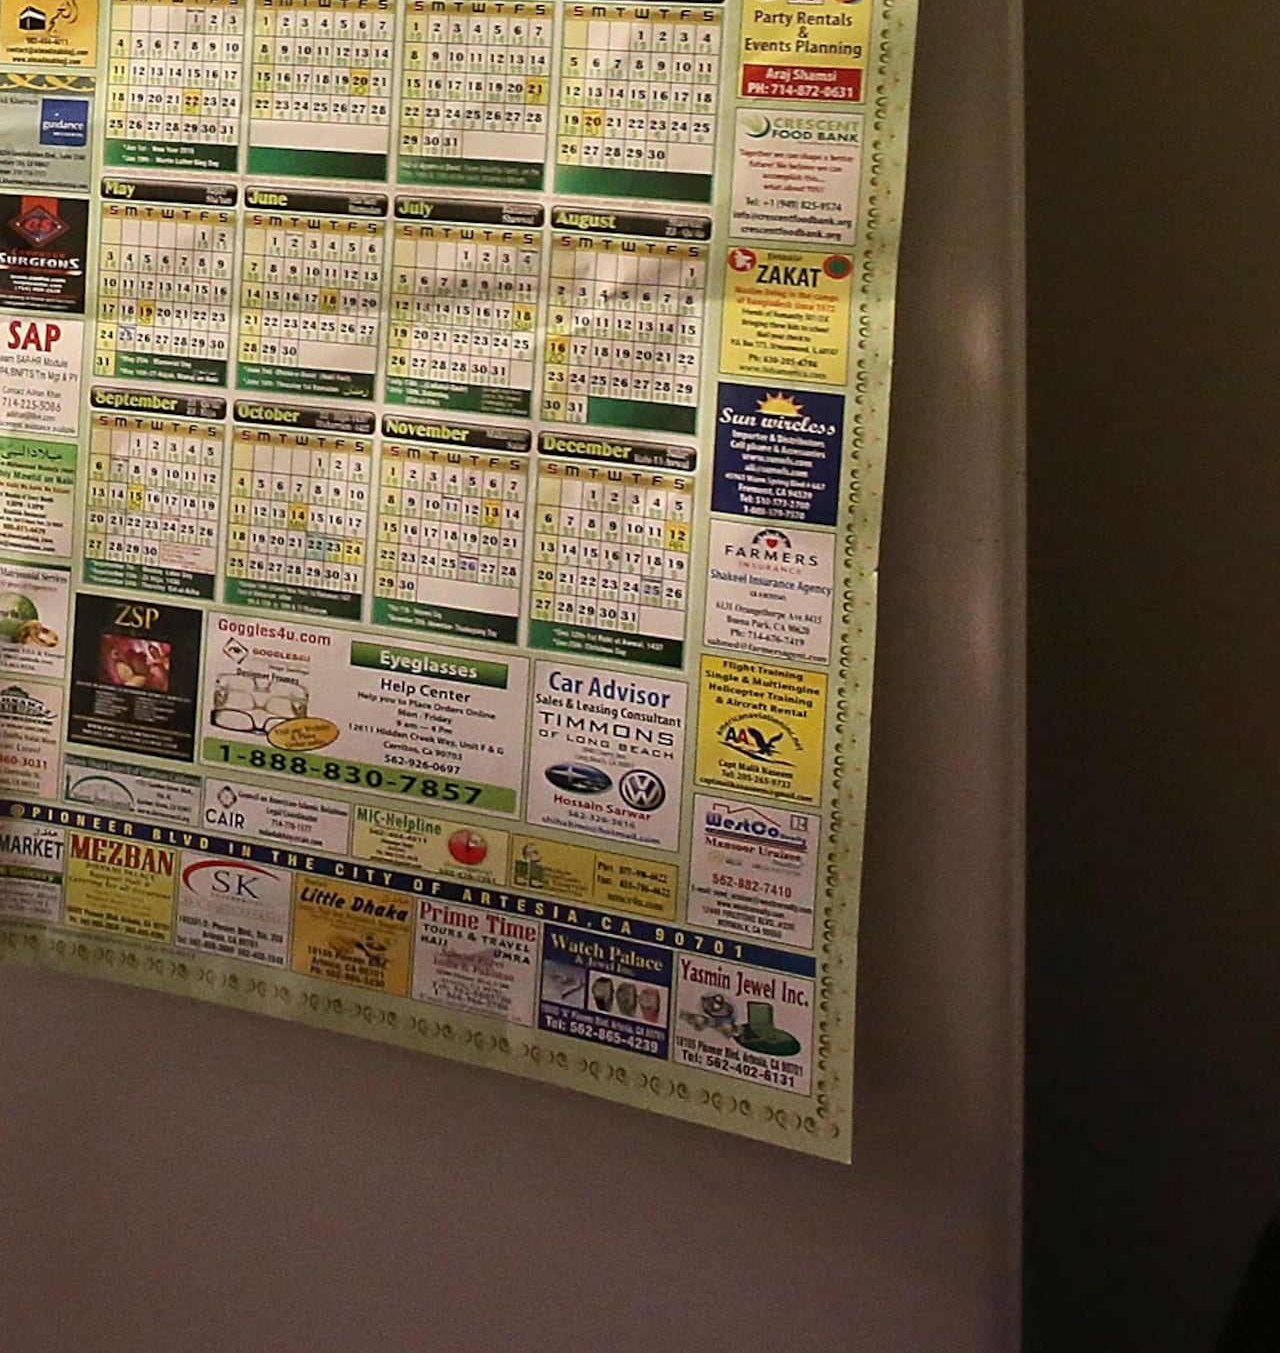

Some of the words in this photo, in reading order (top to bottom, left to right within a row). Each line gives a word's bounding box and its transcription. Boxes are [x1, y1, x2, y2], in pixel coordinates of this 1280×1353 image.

[753, 9, 793, 28] Party
[796, 11, 853, 27] Rentals
[798, 26, 809, 39] &
[744, 37, 792, 53] Events
[795, 39, 863, 59] Planning
[772, 127, 813, 141] FOOD
[817, 130, 860, 144] BANK
[773, 116, 860, 132] CRESCENT
[104, 180, 136, 198] May
[247, 191, 289, 207] June
[397, 200, 435, 219] July
[555, 210, 618, 230] August
[756, 264, 822, 288] ZAKAT
[7, 320, 62, 353] SAP
[95, 390, 179, 414] September
[237, 402, 301, 424] October
[385, 418, 471, 443] November
[719, 406, 758, 427] Sun
[760, 415, 837, 436] wireless
[542, 436, 633, 460] December
[724, 544, 820, 567] FARMERS
[749, 573, 796, 591] Insurance
[796, 579, 833, 597] Agency
[113, 603, 161, 630] ZSP
[217, 617, 332, 647] Goggles4u.com
[378, 649, 478, 679] Eyeglasses
[722, 659, 756, 675] Flight
[757, 664, 804, 683] Training
[380, 677, 416, 698] Help
[419, 682, 471, 703] Center
[548, 670, 584, 694] Car
[588, 676, 671, 709] Advisor
[704, 669, 739, 683] Single
[751, 676, 821, 696] Multiengine
[708, 681, 765, 701] Helicopter
[766, 690, 814, 709] Training
[535, 693, 564, 708] Sales
[576, 699, 619, 720] Leasing
[620, 706, 682, 728] Consultant
[726, 696, 768, 712] Aircraft
[769, 703, 808, 719] Rental
[538, 710, 675, 747] TIMMONS
[538, 728, 559, 739] OF
[566, 733, 610, 749] LONG
[618, 742, 675, 760] BEACH
[219, 744, 483, 806] 1-888-830-7857
[205, 808, 246, 829] CAIR
[553, 793, 604, 813] Hossain
[605, 804, 652, 822] Sarwar
[356, 807, 442, 836] MIC-Helpline
[71, 833, 175, 877] MEZBAN
[31, 805, 134, 836] PIONEER
[152, 828, 210, 850] BLVD
[228, 842, 252, 858] IN
[271, 850, 316, 871] THE
[334, 862, 393, 887] CITY
[412, 877, 441, 895] OF
[654, 930, 744, 959] 90701
[211, 870, 260, 899] SK
[300, 886, 346, 910] Little
[351, 896, 410, 923] Dhaka
[419, 900, 480, 931] Prime
[486, 914, 537, 943] Time
[423, 923, 464, 939] TOURS
[482, 935, 531, 954] TRAVEL
[492, 949, 531, 966] UMRA
[550, 932, 605, 961] Watch
[609, 947, 664, 973] Palace
[680, 958, 731, 991] Yasmin
[735, 970, 776, 1001] Jewel
[781, 983, 810, 1007] Inc.
[544, 1014, 566, 1032] Tel:
[682, 1049, 703, 1065] Tel:
